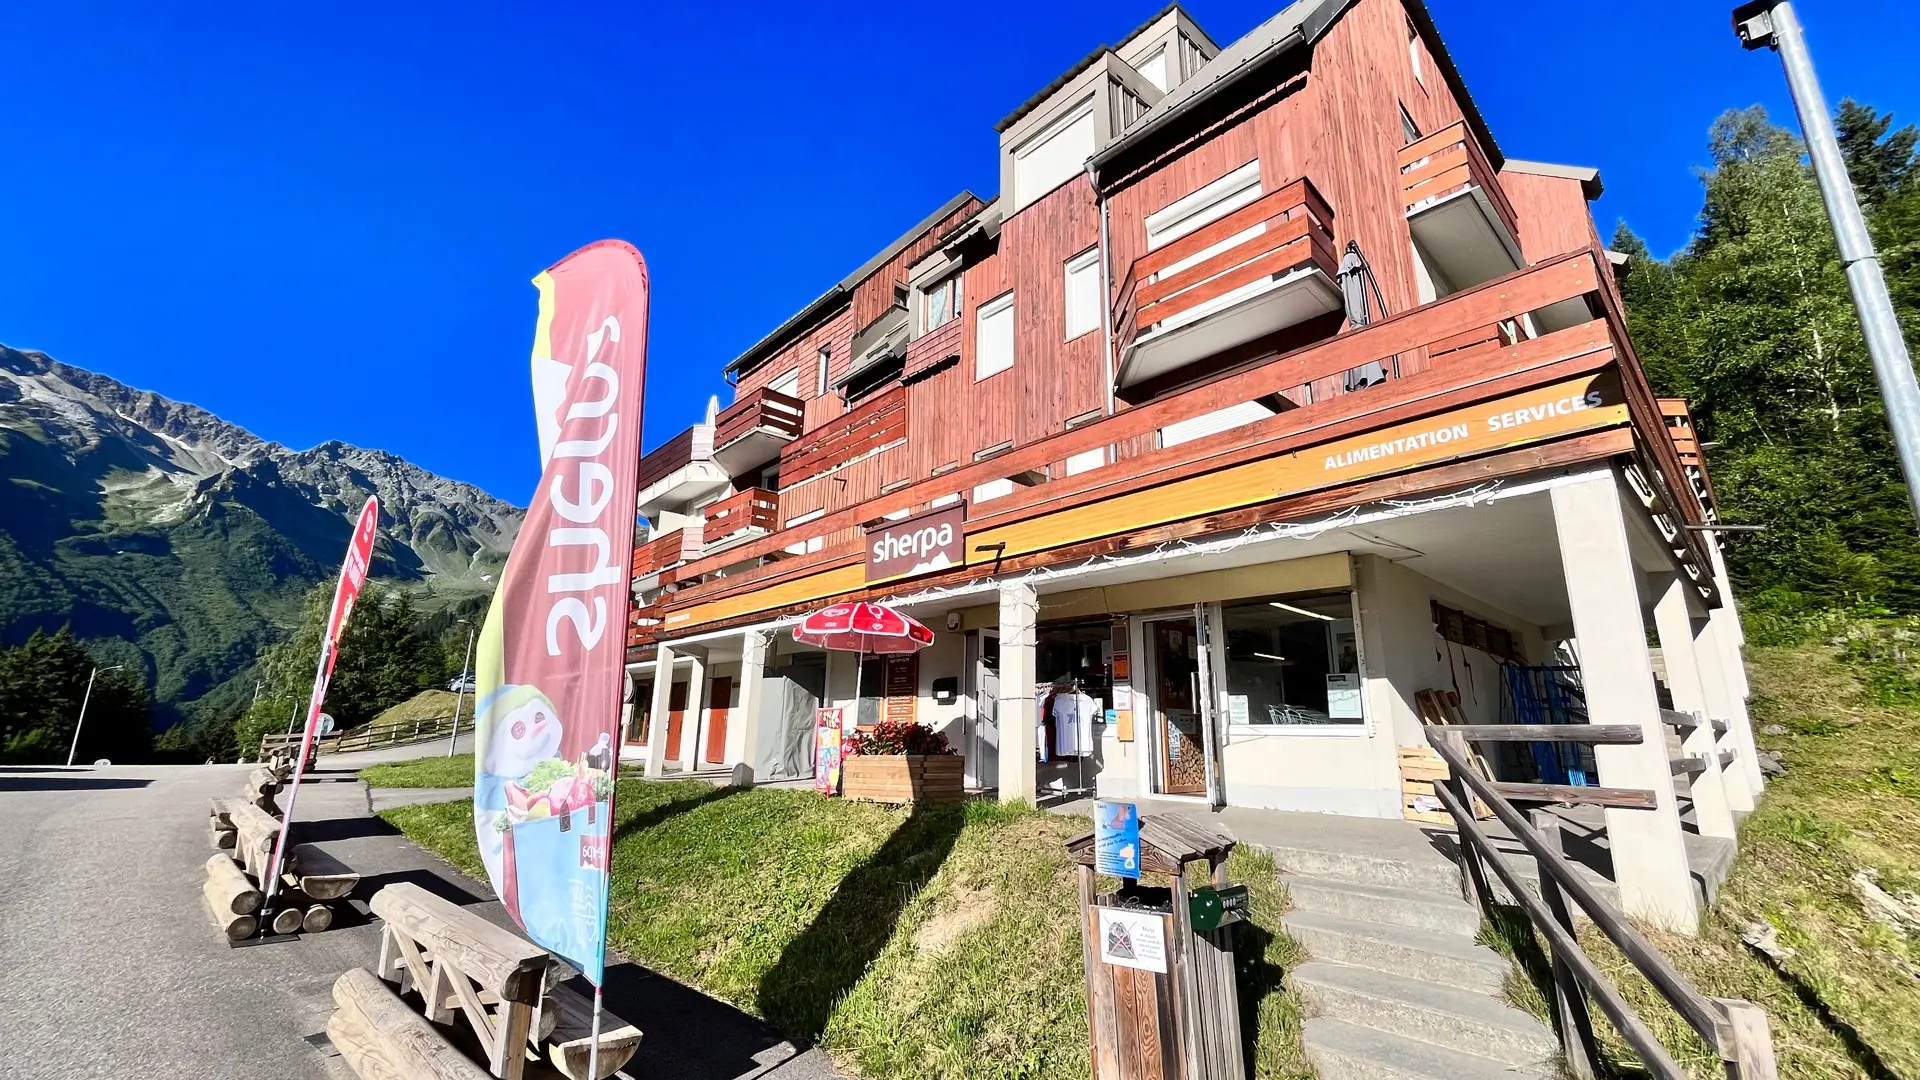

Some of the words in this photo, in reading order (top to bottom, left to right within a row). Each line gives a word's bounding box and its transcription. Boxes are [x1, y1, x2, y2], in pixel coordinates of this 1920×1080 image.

[1324, 423, 1469, 471] ALIMENTATION
[1487, 390, 1603, 432] SERVICES
[872, 521, 954, 564] sherpa
